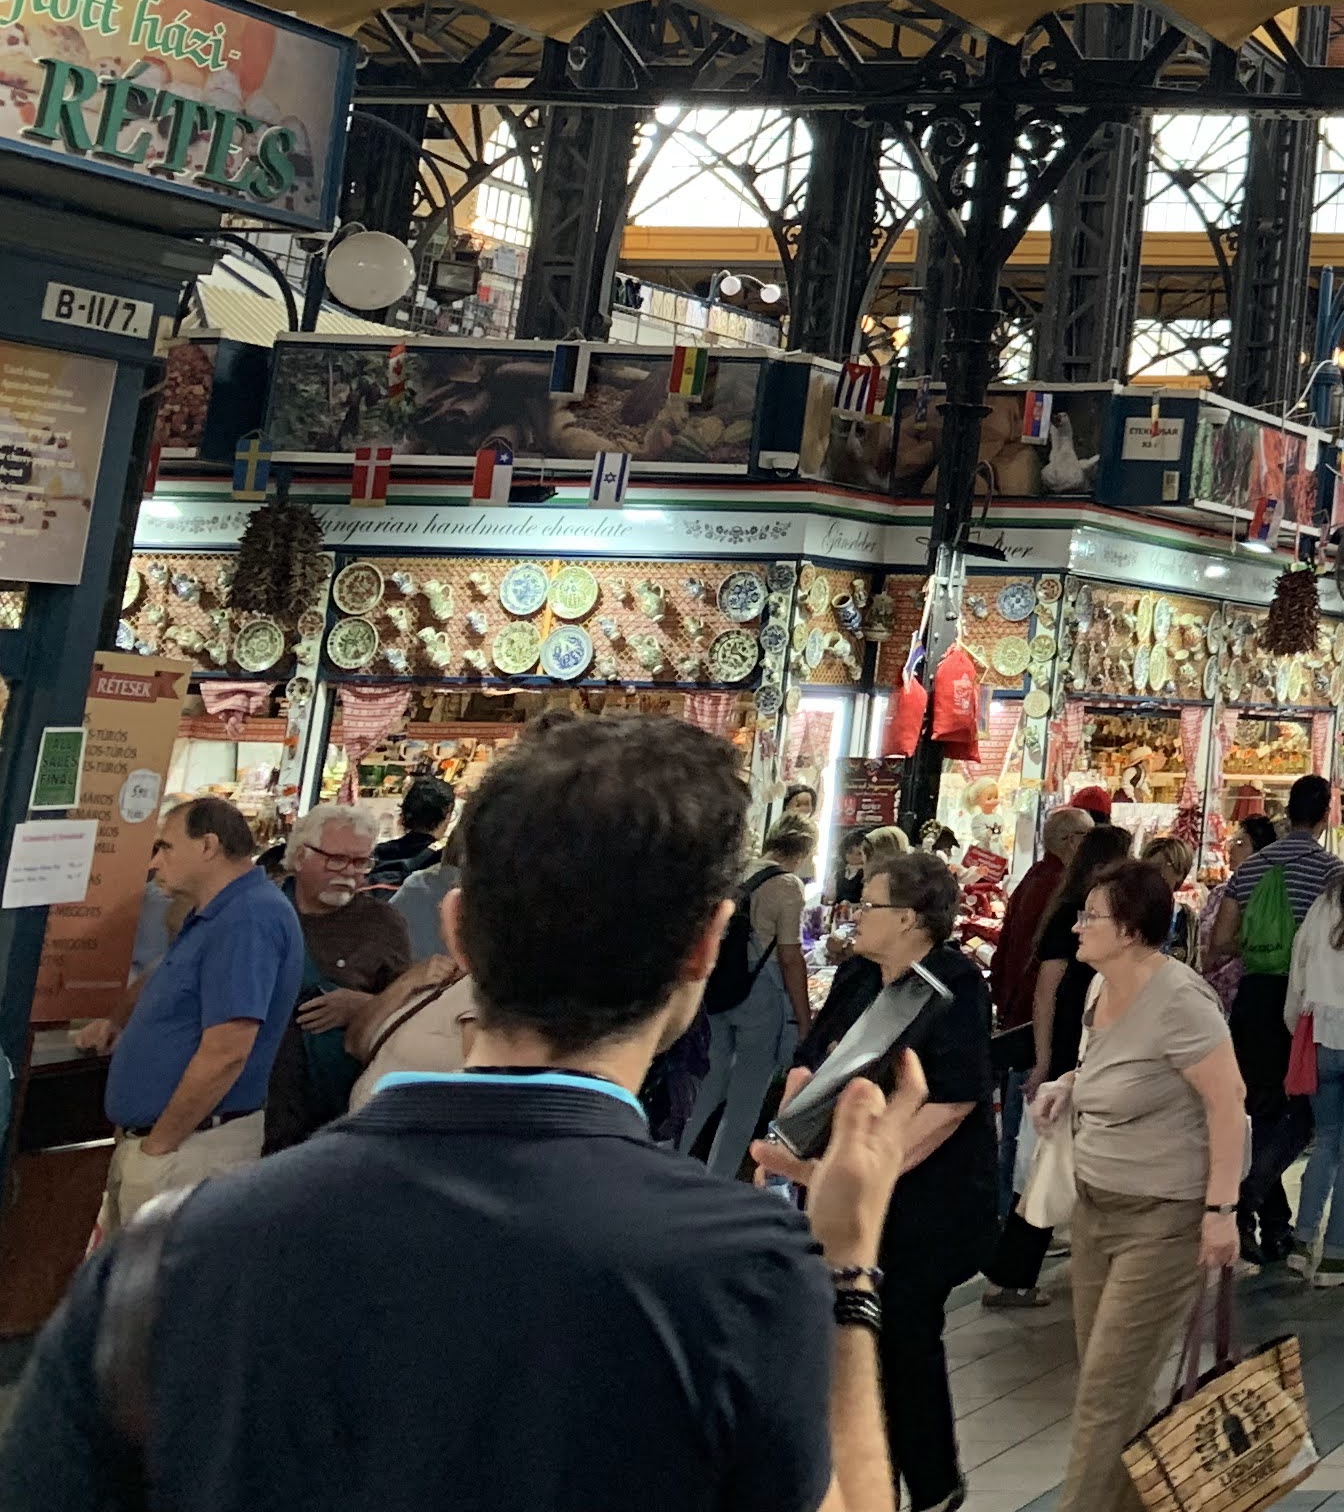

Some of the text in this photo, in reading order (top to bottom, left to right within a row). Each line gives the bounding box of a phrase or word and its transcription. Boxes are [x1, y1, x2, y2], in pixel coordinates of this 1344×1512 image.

[20, 56, 299, 202] RÉTES
[422, 513, 539, 537] handmade
[541, 515, 634, 538] chocolate
[97, 674, 152, 698] RÉTESEK
[39, 774, 74, 787] FINAL
